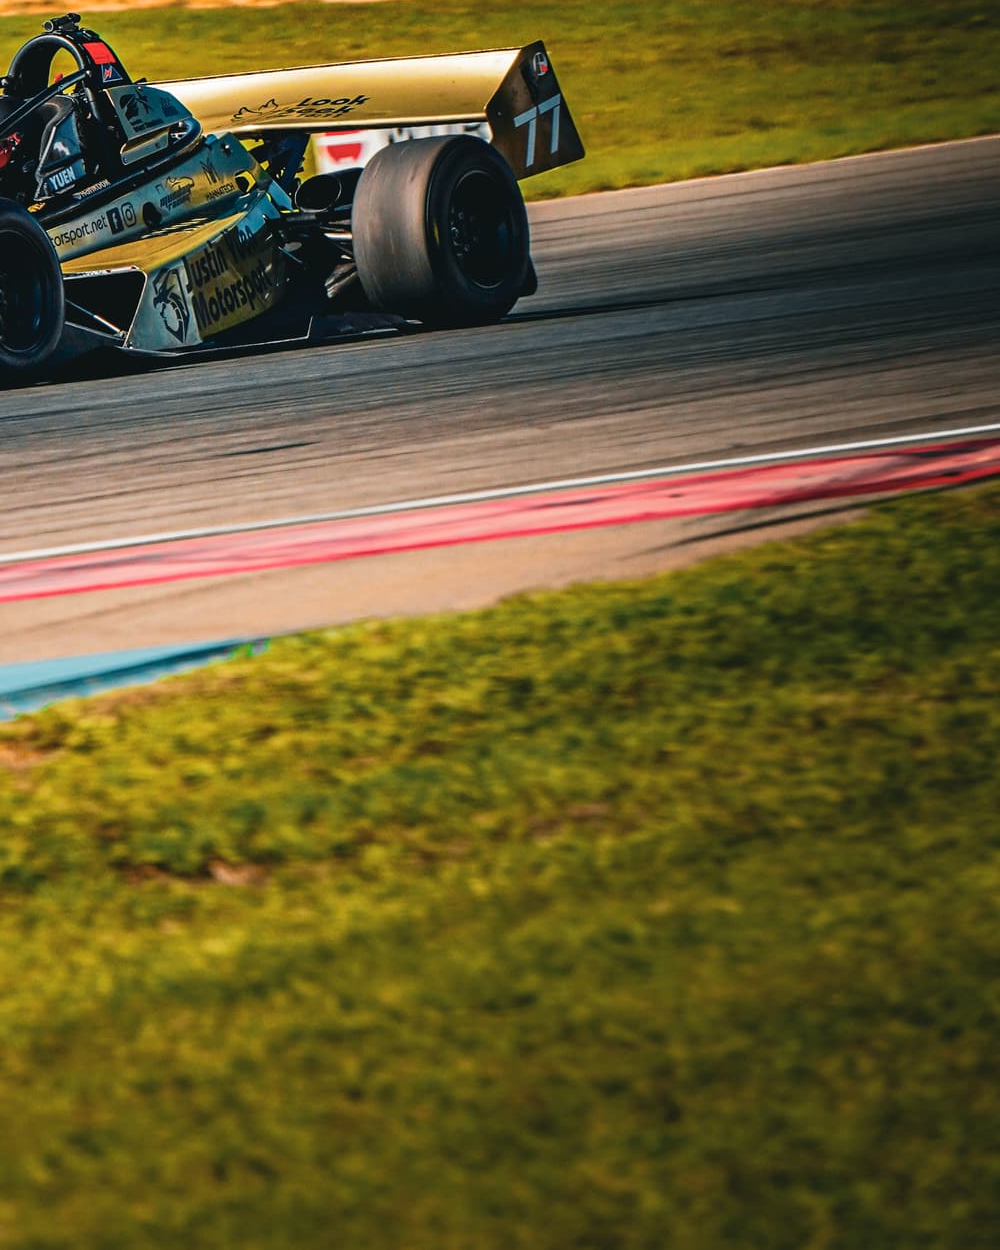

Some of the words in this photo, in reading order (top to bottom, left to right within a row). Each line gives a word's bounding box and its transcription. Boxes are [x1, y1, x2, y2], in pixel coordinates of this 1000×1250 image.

[296, 94, 370, 107] Look
[513, 93, 561, 167] 77
[49, 166, 76, 190] YUEN
[180, 240, 229, 294] Justin
[191, 258, 274, 331] Motorsport
